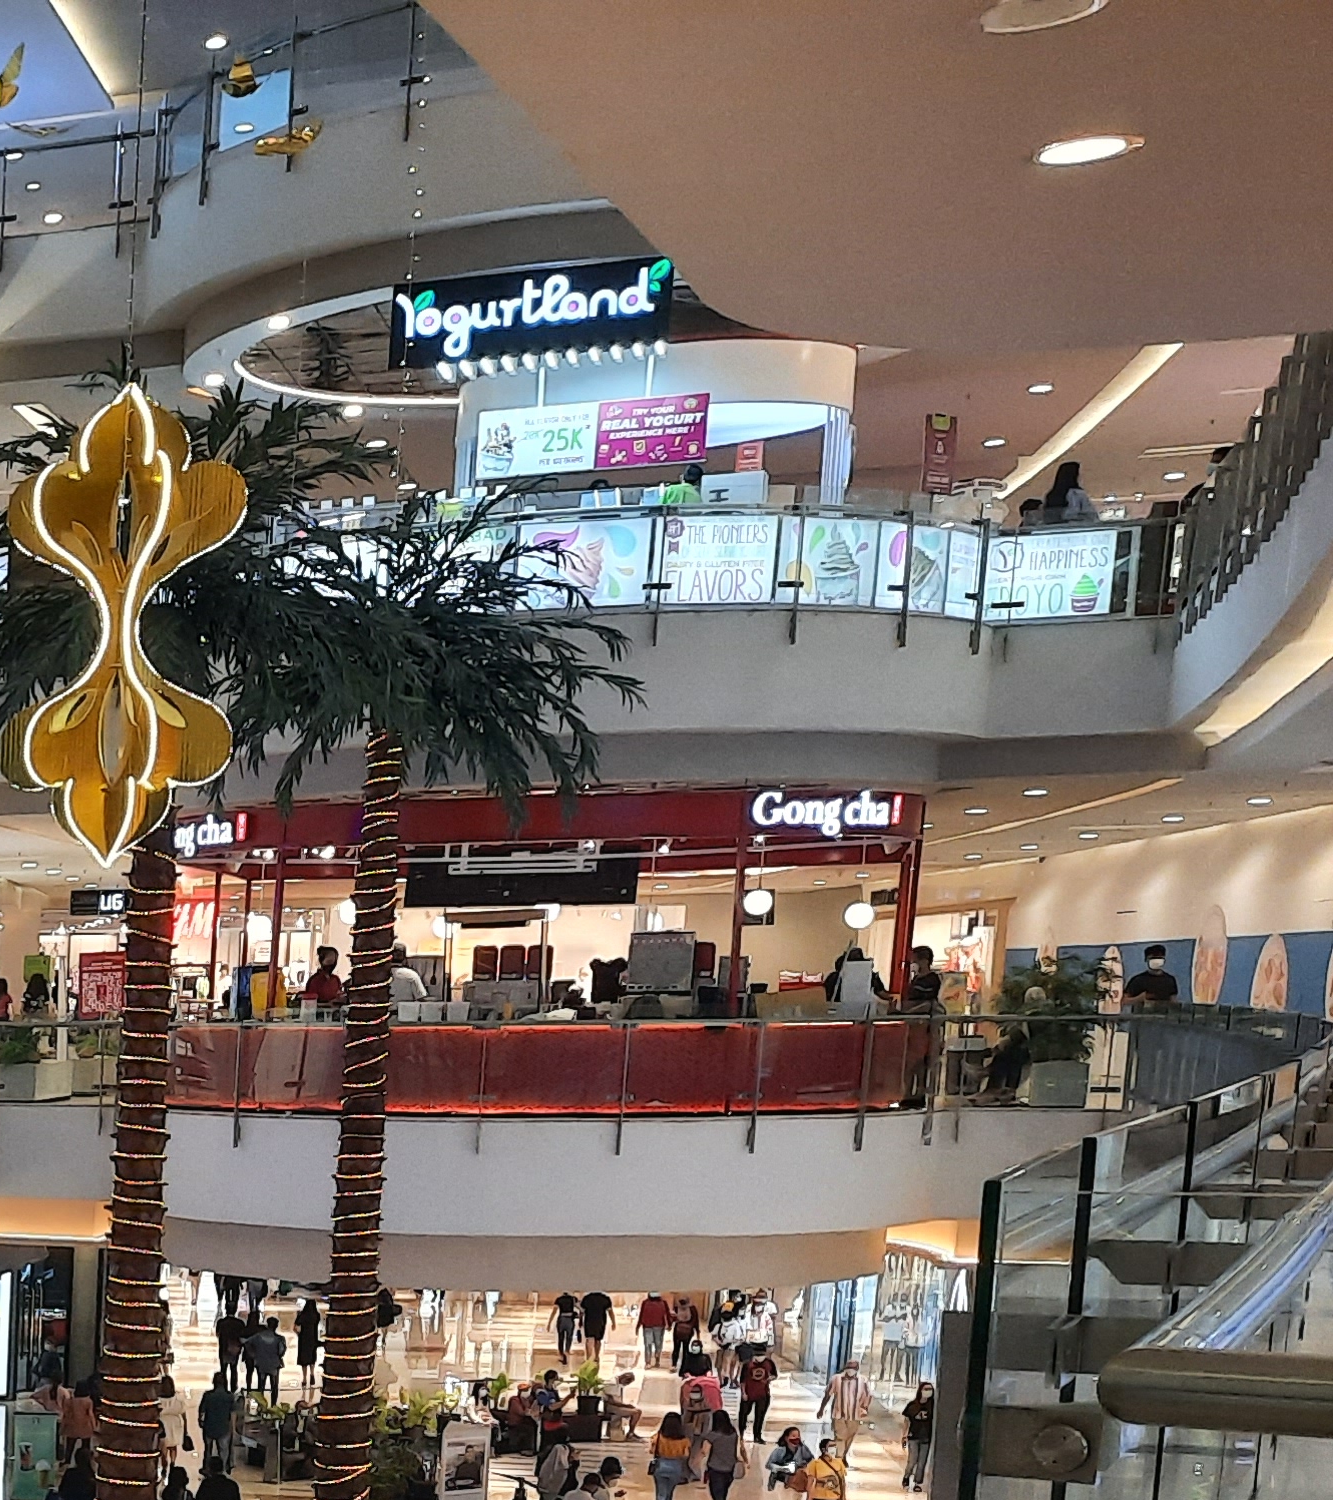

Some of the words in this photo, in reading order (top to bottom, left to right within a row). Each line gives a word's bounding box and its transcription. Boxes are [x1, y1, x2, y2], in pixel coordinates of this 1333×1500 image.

[395, 266, 655, 358] Yogurtland
[600, 417, 640, 432] REAL
[644, 412, 705, 427] YOGURT
[633, 407, 649, 416] TRY
[651, 405, 676, 415] YOUR
[542, 427, 583, 453] 25K
[608, 428, 663, 440] EXPERIENCE
[686, 525, 707, 545] THE
[712, 523, 769, 545] PIONEERS
[1029, 547, 1110, 570] HAPPINESS
[664, 568, 764, 602] FLAVORS
[752, 791, 843, 837] Gong
[844, 790, 890, 826] cha
[197, 814, 234, 846] cha
[99, 893, 124, 911] UG
